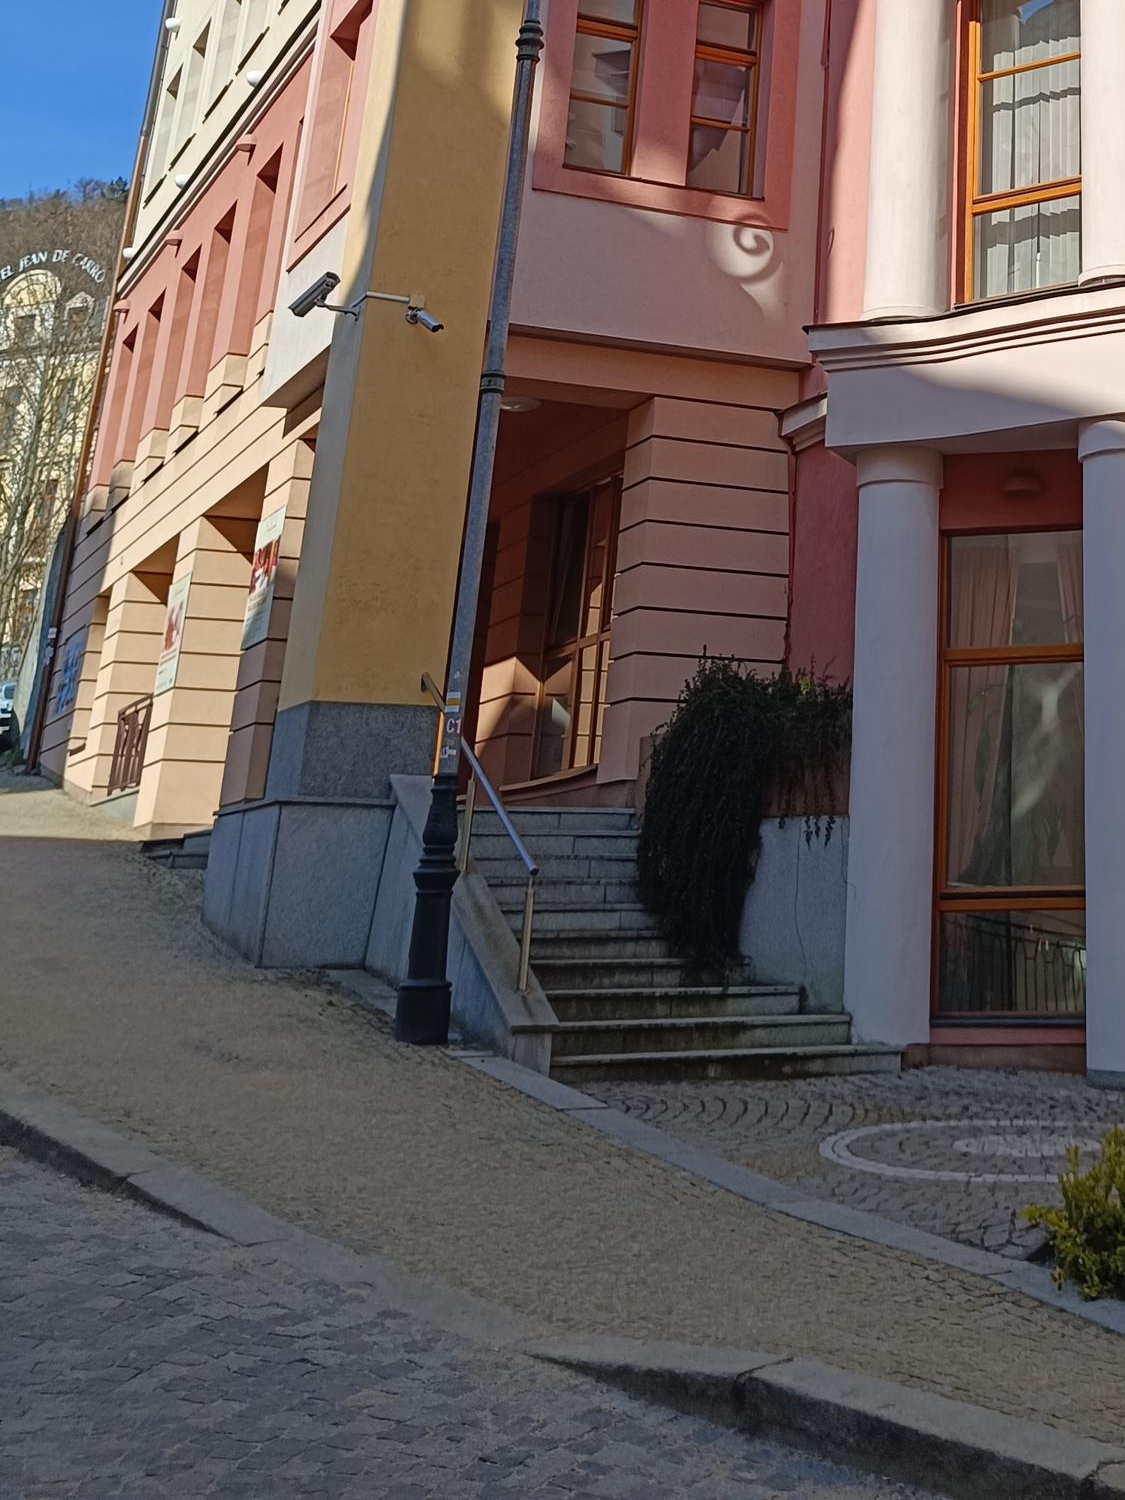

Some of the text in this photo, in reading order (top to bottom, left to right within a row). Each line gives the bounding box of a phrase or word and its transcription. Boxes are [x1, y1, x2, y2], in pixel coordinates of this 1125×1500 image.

[0, 249, 106, 283] EL JEAN DE CARRO
